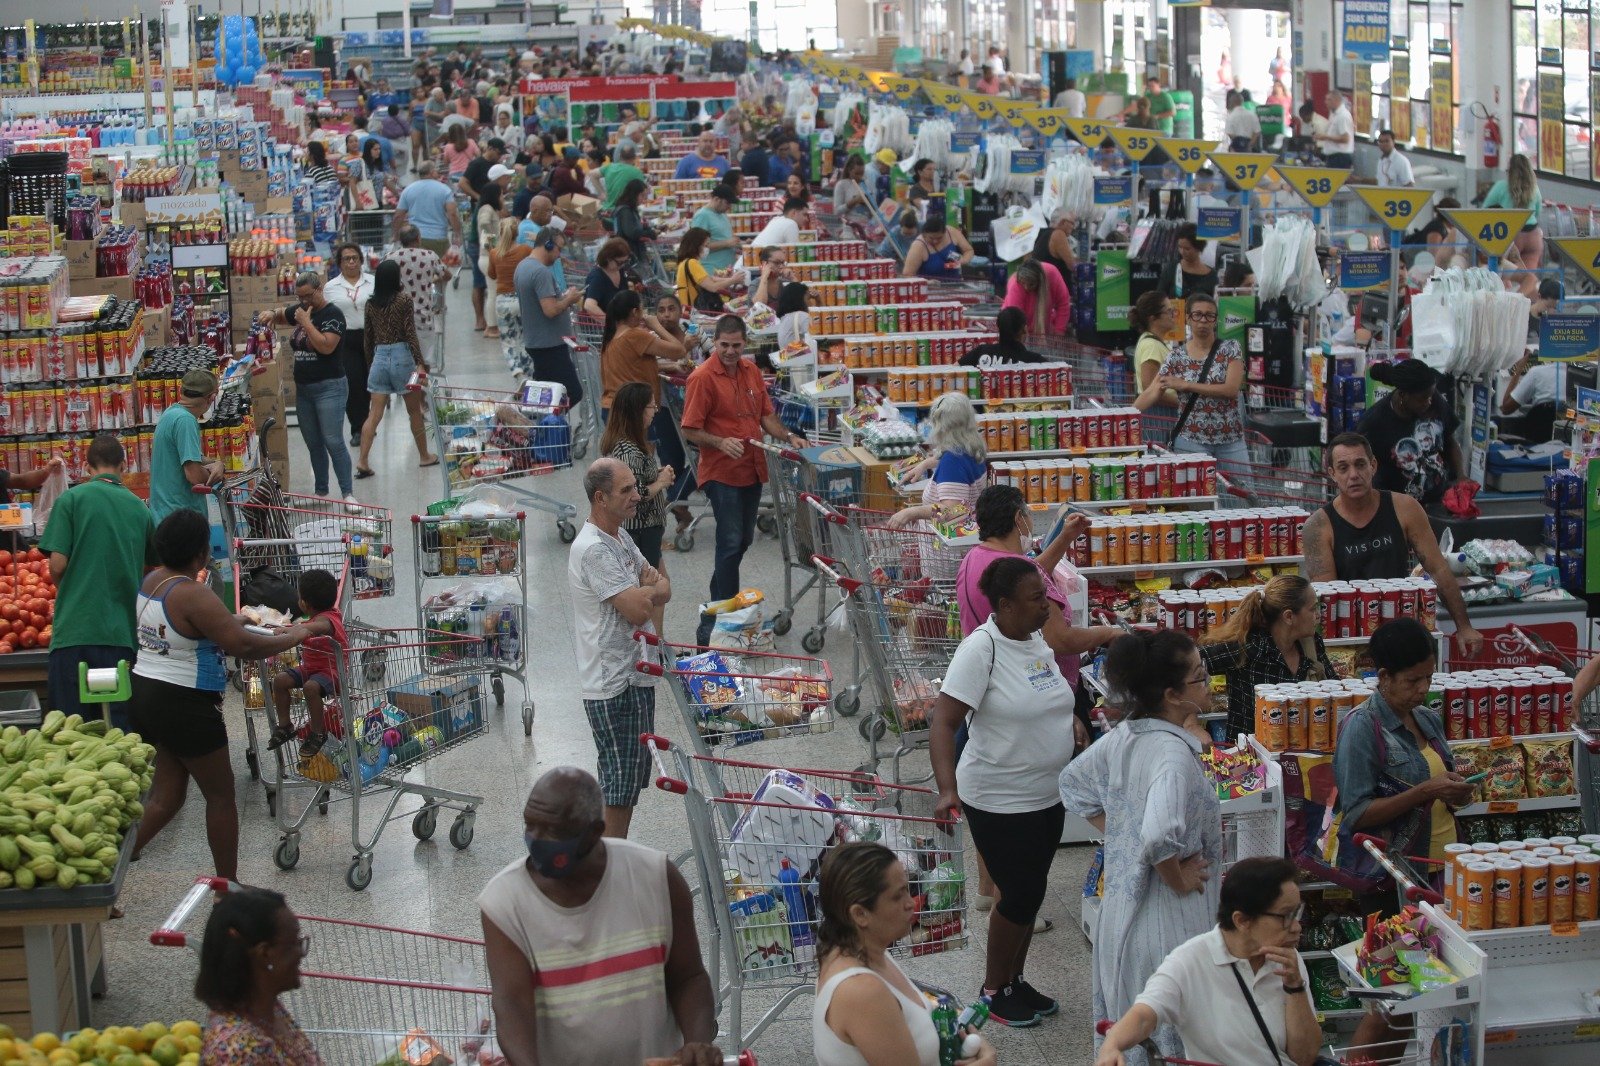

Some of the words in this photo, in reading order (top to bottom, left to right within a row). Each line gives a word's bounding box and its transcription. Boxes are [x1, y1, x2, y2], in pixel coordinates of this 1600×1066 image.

[1346, 14, 1365, 23] SUAS
[1367, 14, 1388, 24] MÃOS
[1346, 25, 1387, 43] AQUI!
[895, 83, 910, 93] 28
[945, 94, 961, 104] 30
[1038, 116, 1057, 128] 33
[1082, 124, 1102, 136] 34
[1128, 137, 1148, 150] 35
[1178, 147, 1200, 161] 36
[1235, 164, 1258, 180] 37
[1306, 178, 1331, 195] 38
[160, 201, 207, 210] mozcada
[1384, 200, 1412, 218] 39
[1478, 221, 1509, 242] 40
[1104, 268, 1122, 276] Trident
[1133, 271, 1158, 279] HALLS
[1225, 317, 1247, 325] Trident
